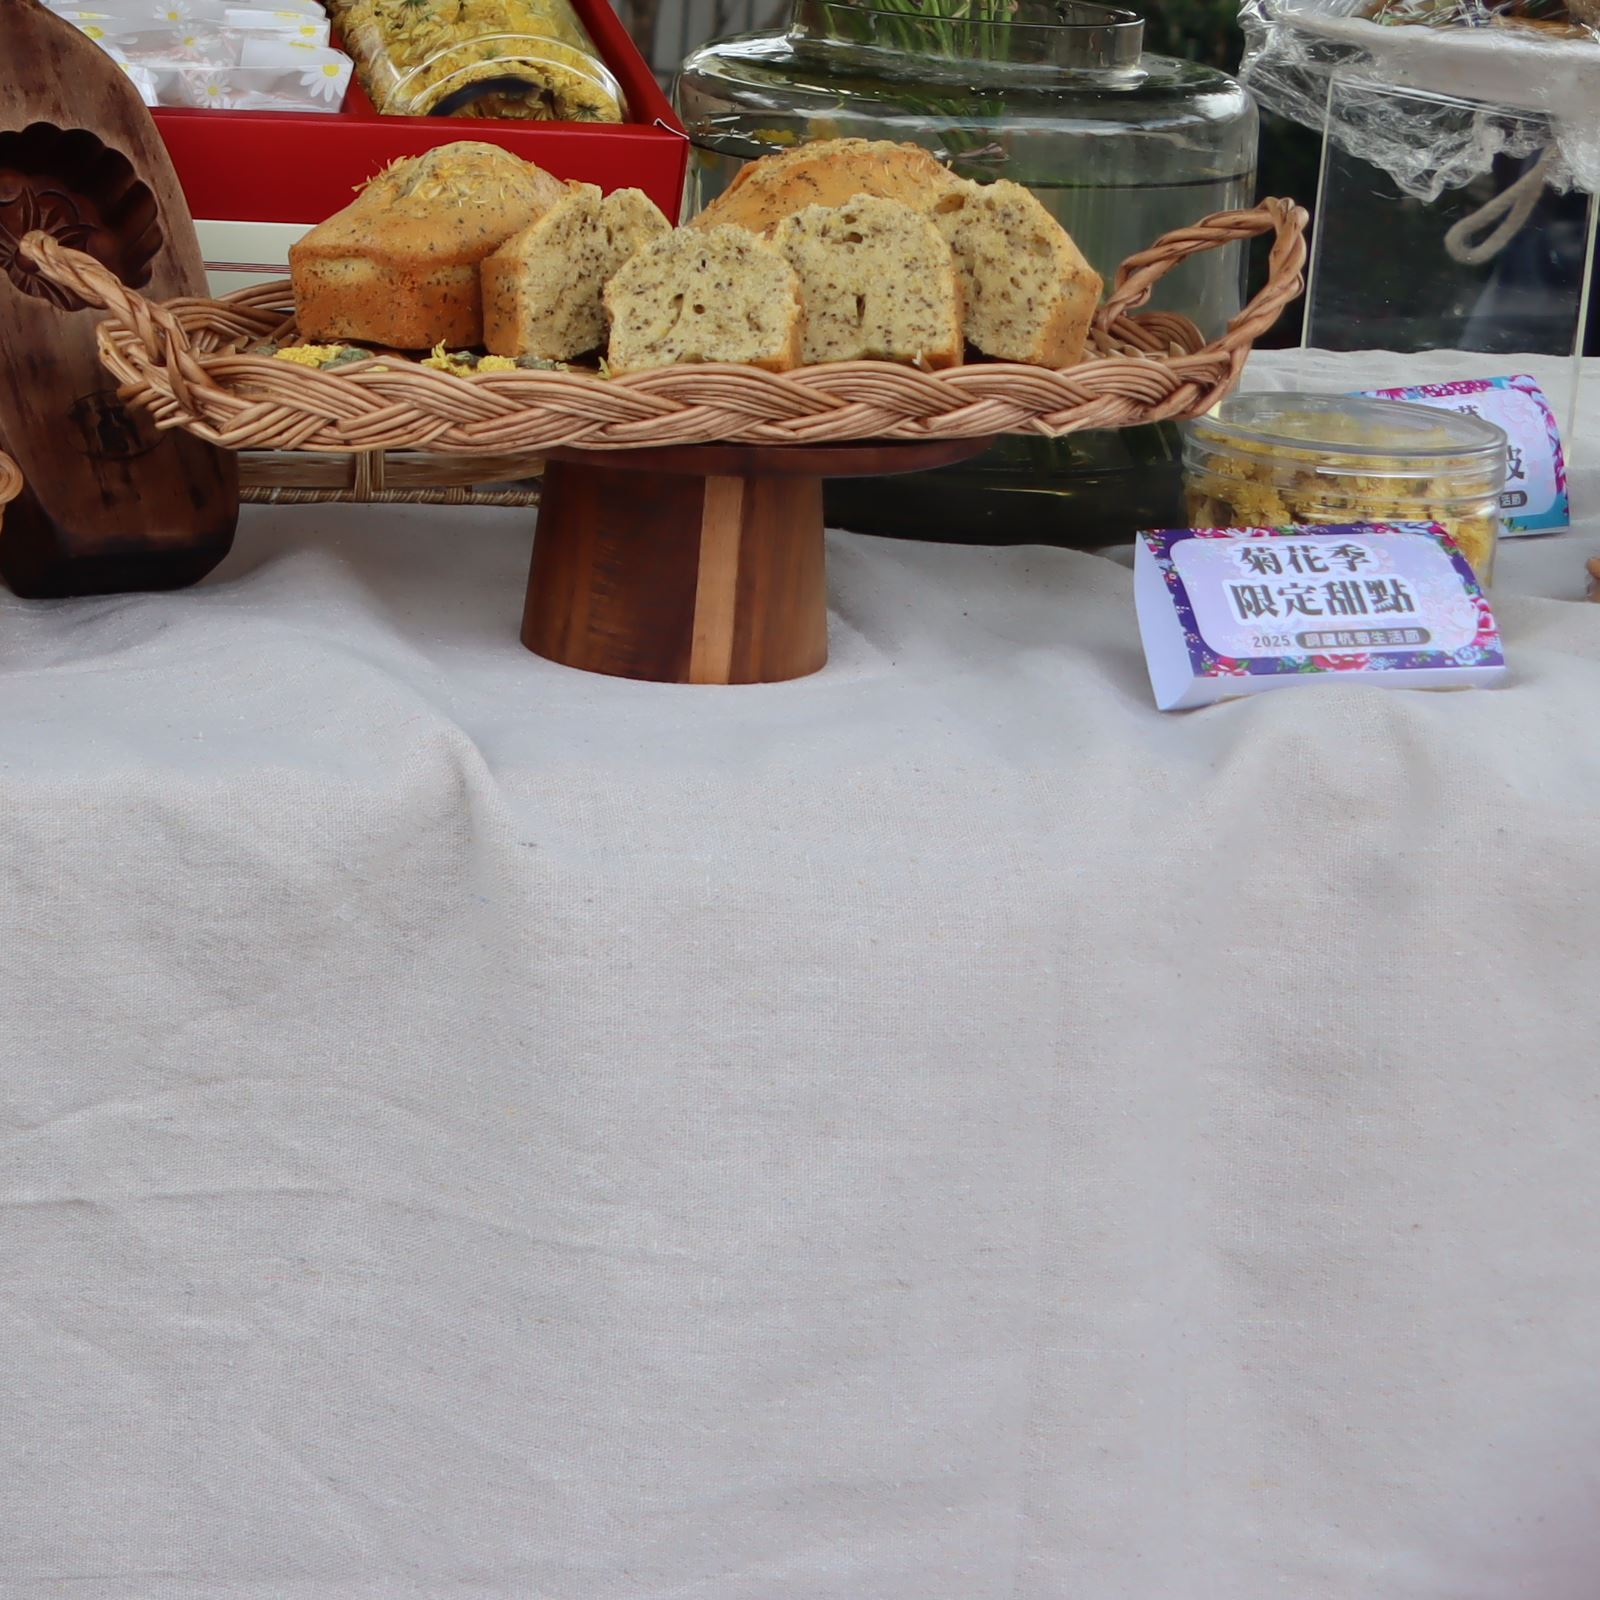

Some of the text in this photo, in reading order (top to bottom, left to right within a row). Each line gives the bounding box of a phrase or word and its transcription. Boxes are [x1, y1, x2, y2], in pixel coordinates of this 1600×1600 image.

[1240, 543, 1372, 575] 菊花季
[1229, 578, 1415, 620] 限定甜點
[1252, 635, 1291, 648] 2025
